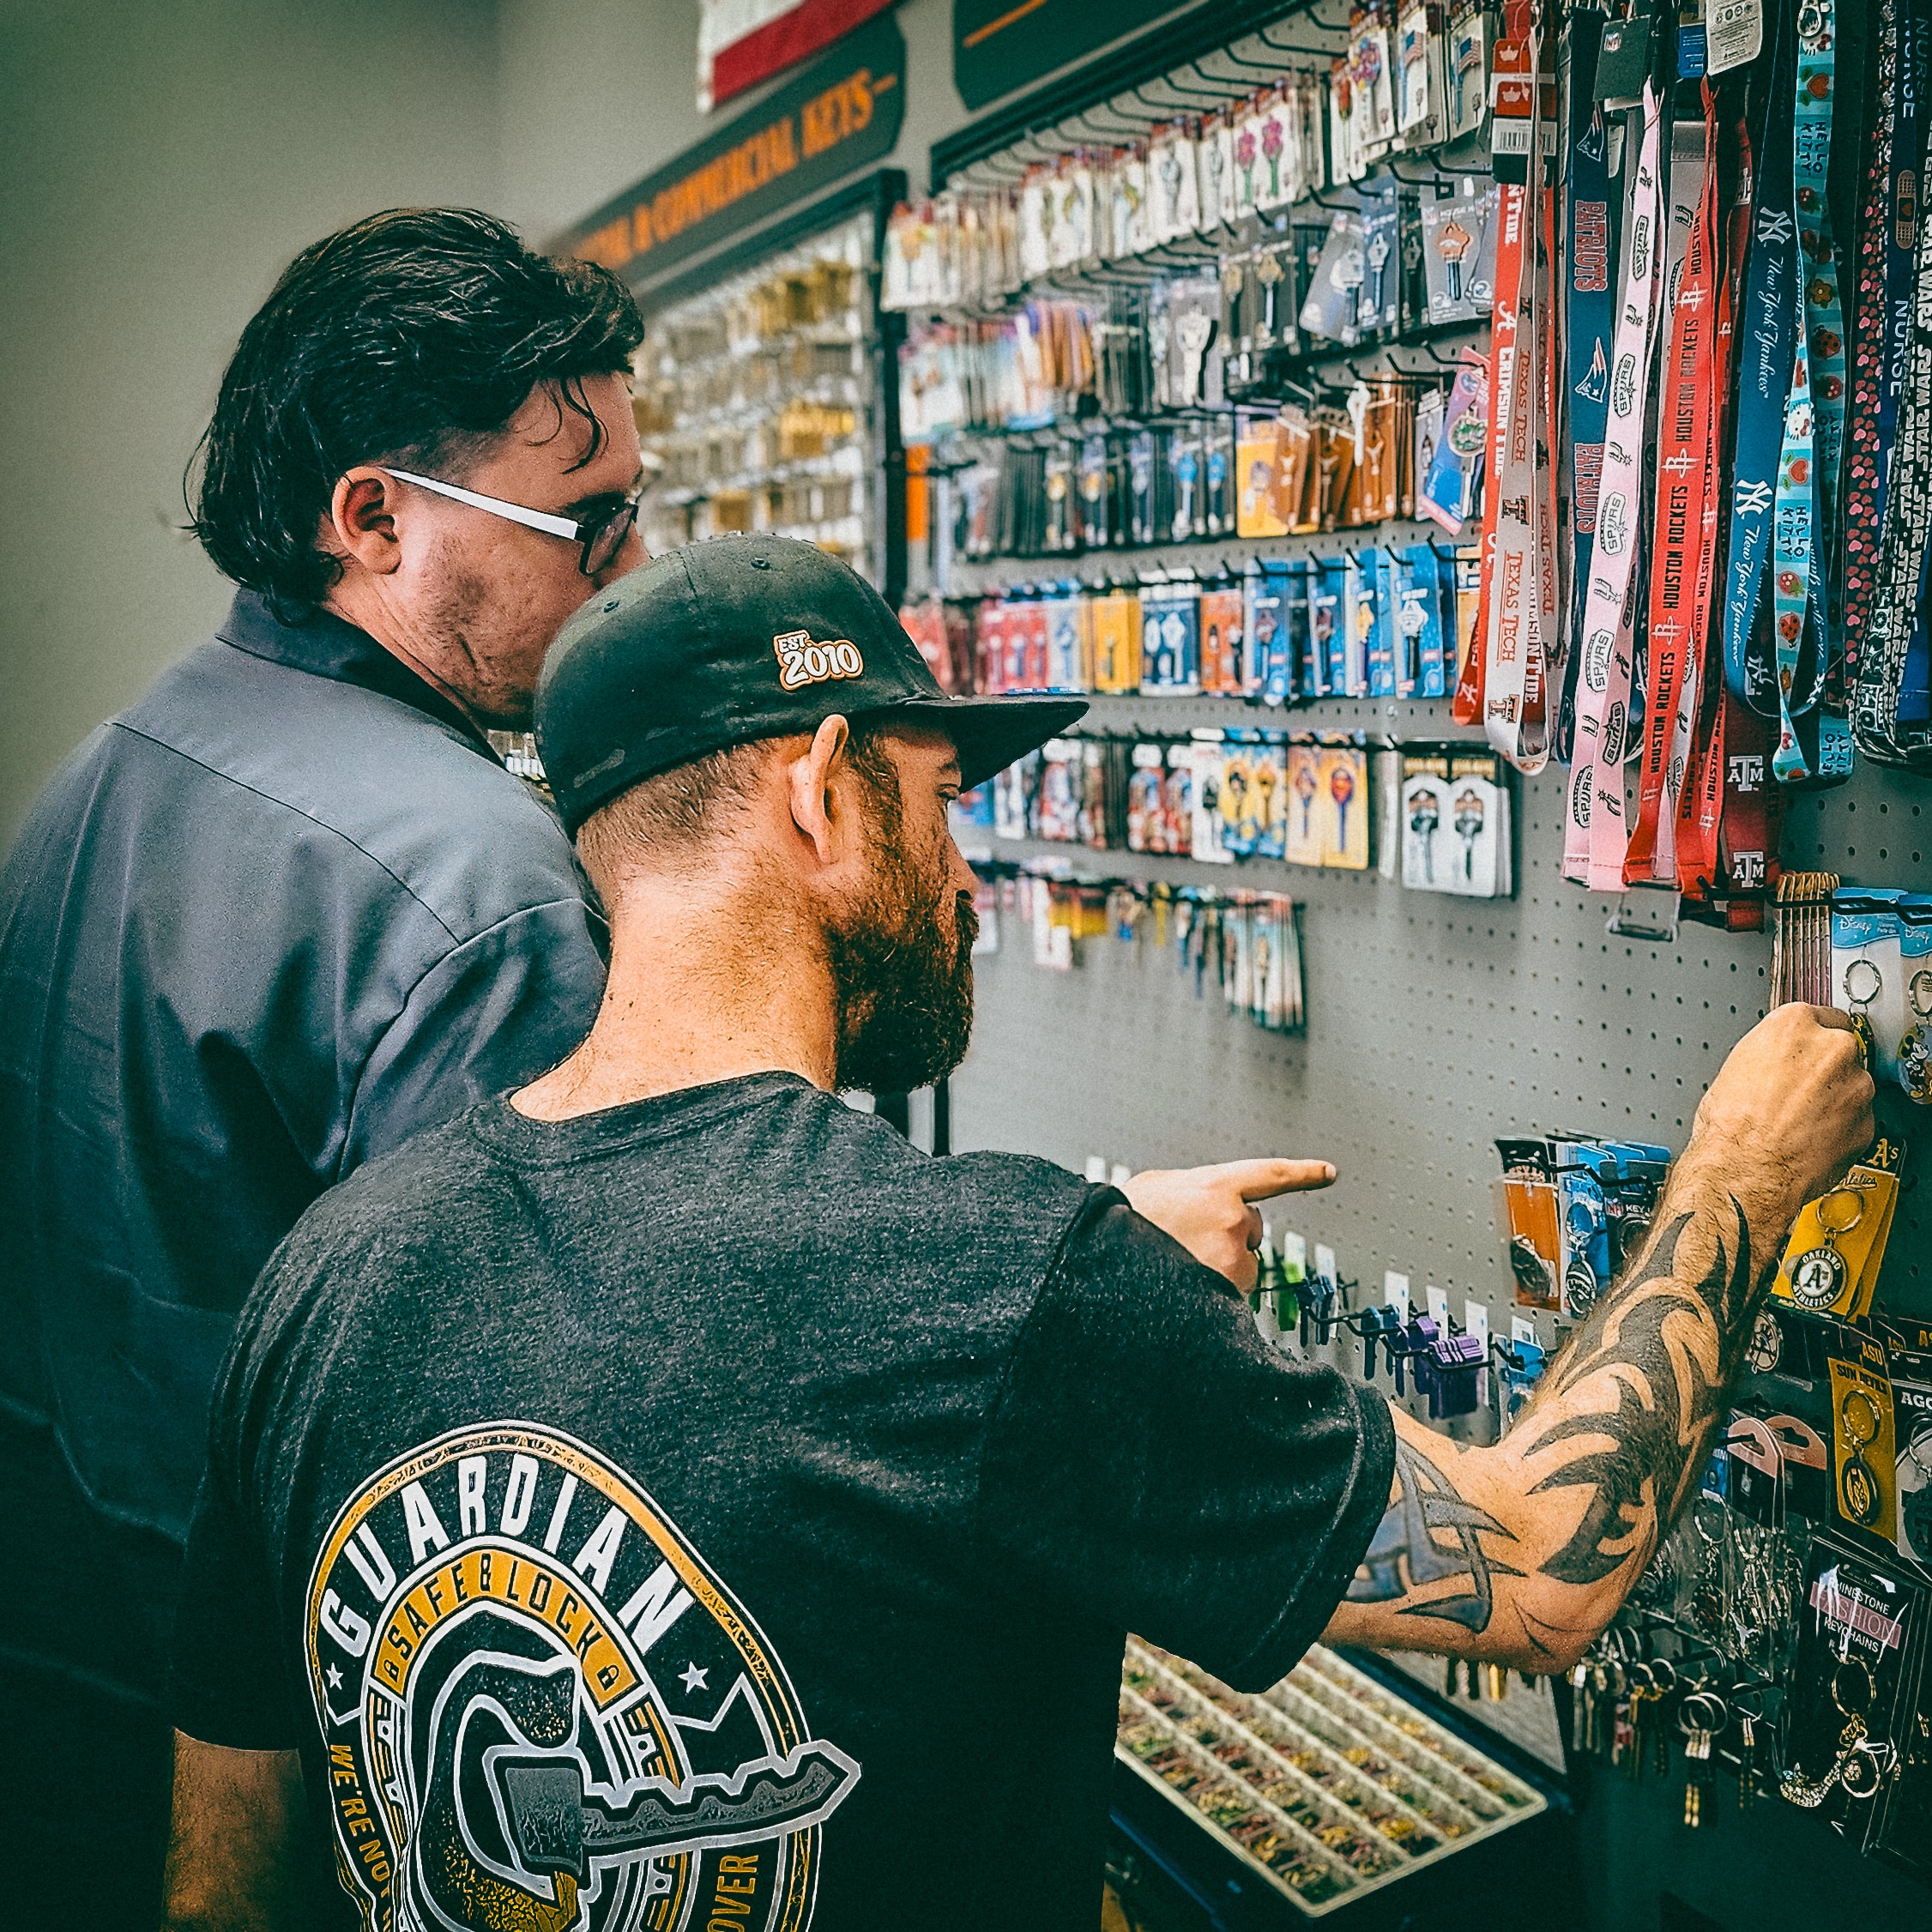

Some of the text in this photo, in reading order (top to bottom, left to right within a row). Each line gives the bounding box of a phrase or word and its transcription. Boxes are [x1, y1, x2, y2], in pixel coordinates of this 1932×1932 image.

[1800, 122, 1814, 174] KITTY
[1812, 121, 1828, 174] HELLO
[1505, 196, 1523, 245] TIDE
[1575, 200, 1608, 293] PATRIOTS
[1689, 214, 1702, 276] HOUSTON
[1753, 257, 1784, 394] New York Yankees
[1890, 299, 1909, 397] NURSE
[1495, 346, 1514, 430] CRIMSON
[1515, 349, 1531, 463] TEXAS TECH
[1619, 358, 1633, 412] SPURS
[1675, 318, 1700, 443] HOUSTON ROCKETS
[1916, 344, 1932, 408] WARS
[1899, 404, 1915, 528] STAR WARS
[1916, 408, 1930, 472] STAR
[1575, 442, 1605, 534] PATRIOTS
[1606, 496, 1622, 550] SPURS
[1663, 485, 1688, 610] HOUSTON ROCKETS
[1779, 507, 1794, 556] KITTY
[1792, 506, 1811, 558] HELLO
[1905, 485, 1926, 613] STAR WARS
[1542, 556, 1555, 616] TEXAS
[1697, 540, 1712, 598] HOUSTON
[1730, 525, 1760, 667] New York Yankees
[1894, 540, 1909, 604] STAR
[1501, 551, 1524, 663] TEXAS TECH
[1891, 606, 1905, 668] WARS
[782, 643, 860, 685] 2010
[1524, 657, 1543, 703] TIDE
[1595, 633, 1610, 687] SPURS
[1607, 706, 1622, 760] SPURS
[1651, 652, 1675, 774] HOUSTON ROCKETS
[1681, 759, 1698, 820] ROCKETS
[1706, 743, 1719, 802] HOUSTON
[1625, 1204, 1645, 1213] KEY
[1802, 1248, 1842, 1271] OAKLAND
[1793, 1283, 1834, 1308] ATHLETICS
[1836, 1363, 1857, 1382] SUN
[1862, 1340, 1883, 1366] ASU
[319, 1452, 696, 1657] GUARDIAN
[389, 1553, 605, 1655] SAFE & LOCK
[1834, 1580, 1891, 1615] HINESTONE
[1824, 1616, 1880, 1653] KEYCHAINS
[329, 1744, 377, 1838] WE'RE
[707, 1854, 759, 1932] OVER
